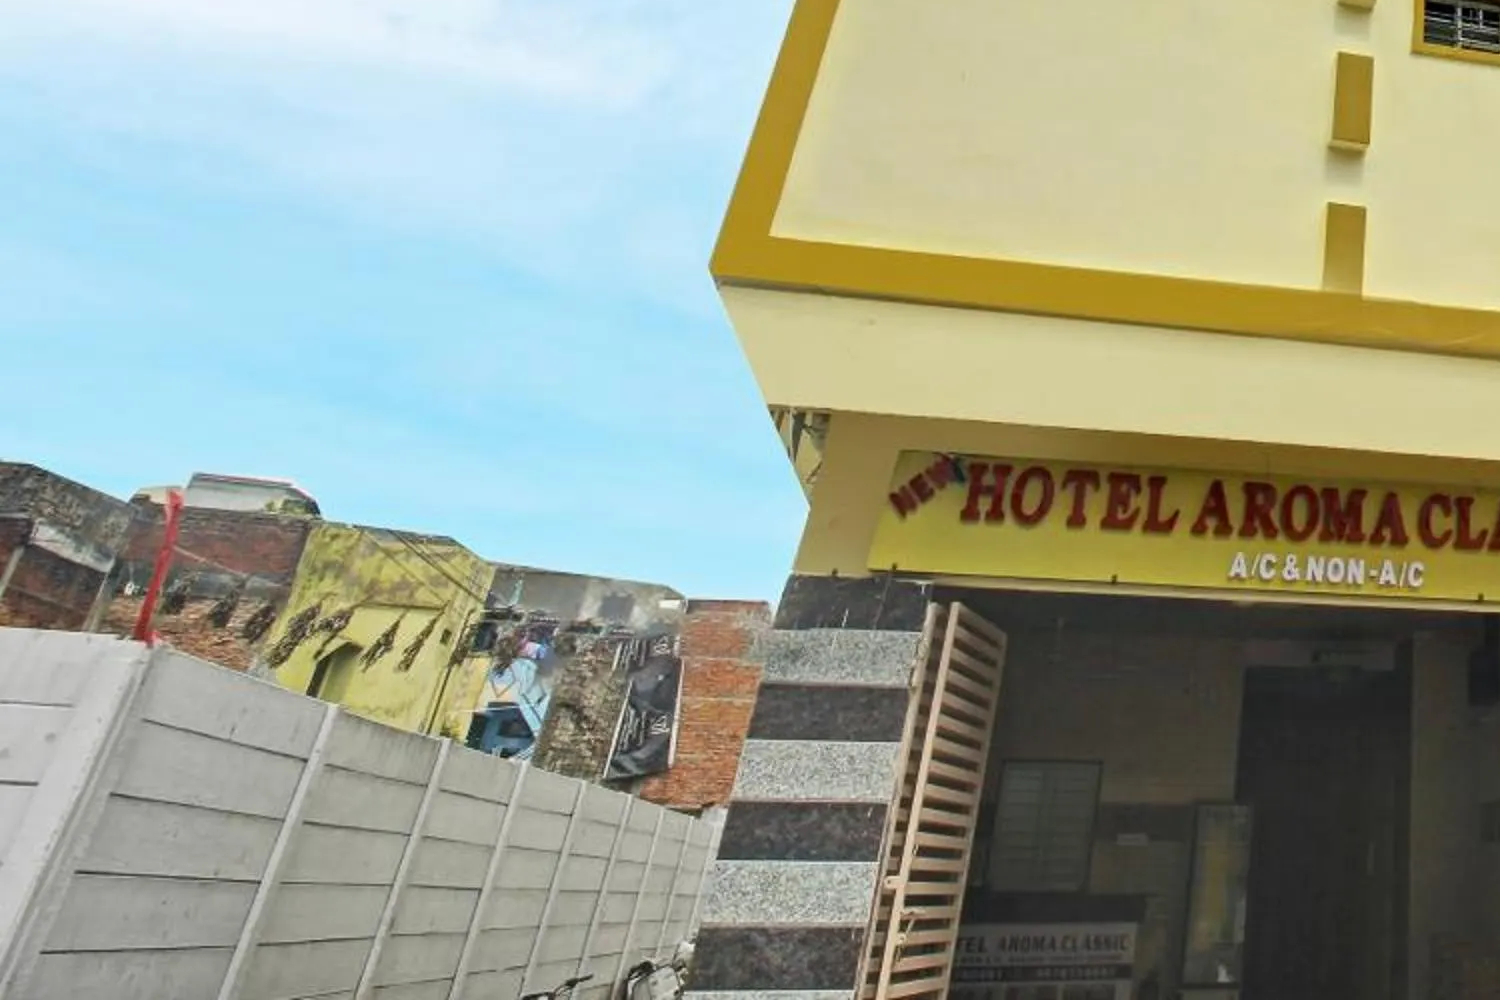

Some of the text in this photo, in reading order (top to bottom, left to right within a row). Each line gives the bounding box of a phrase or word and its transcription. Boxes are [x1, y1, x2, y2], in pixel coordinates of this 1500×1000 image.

[888, 453, 965, 519] NEW
[959, 462, 1180, 534] HOTEL
[1189, 479, 1409, 547] AROMA
[1228, 552, 1277, 580] A/C
[1282, 554, 1300, 581] &
